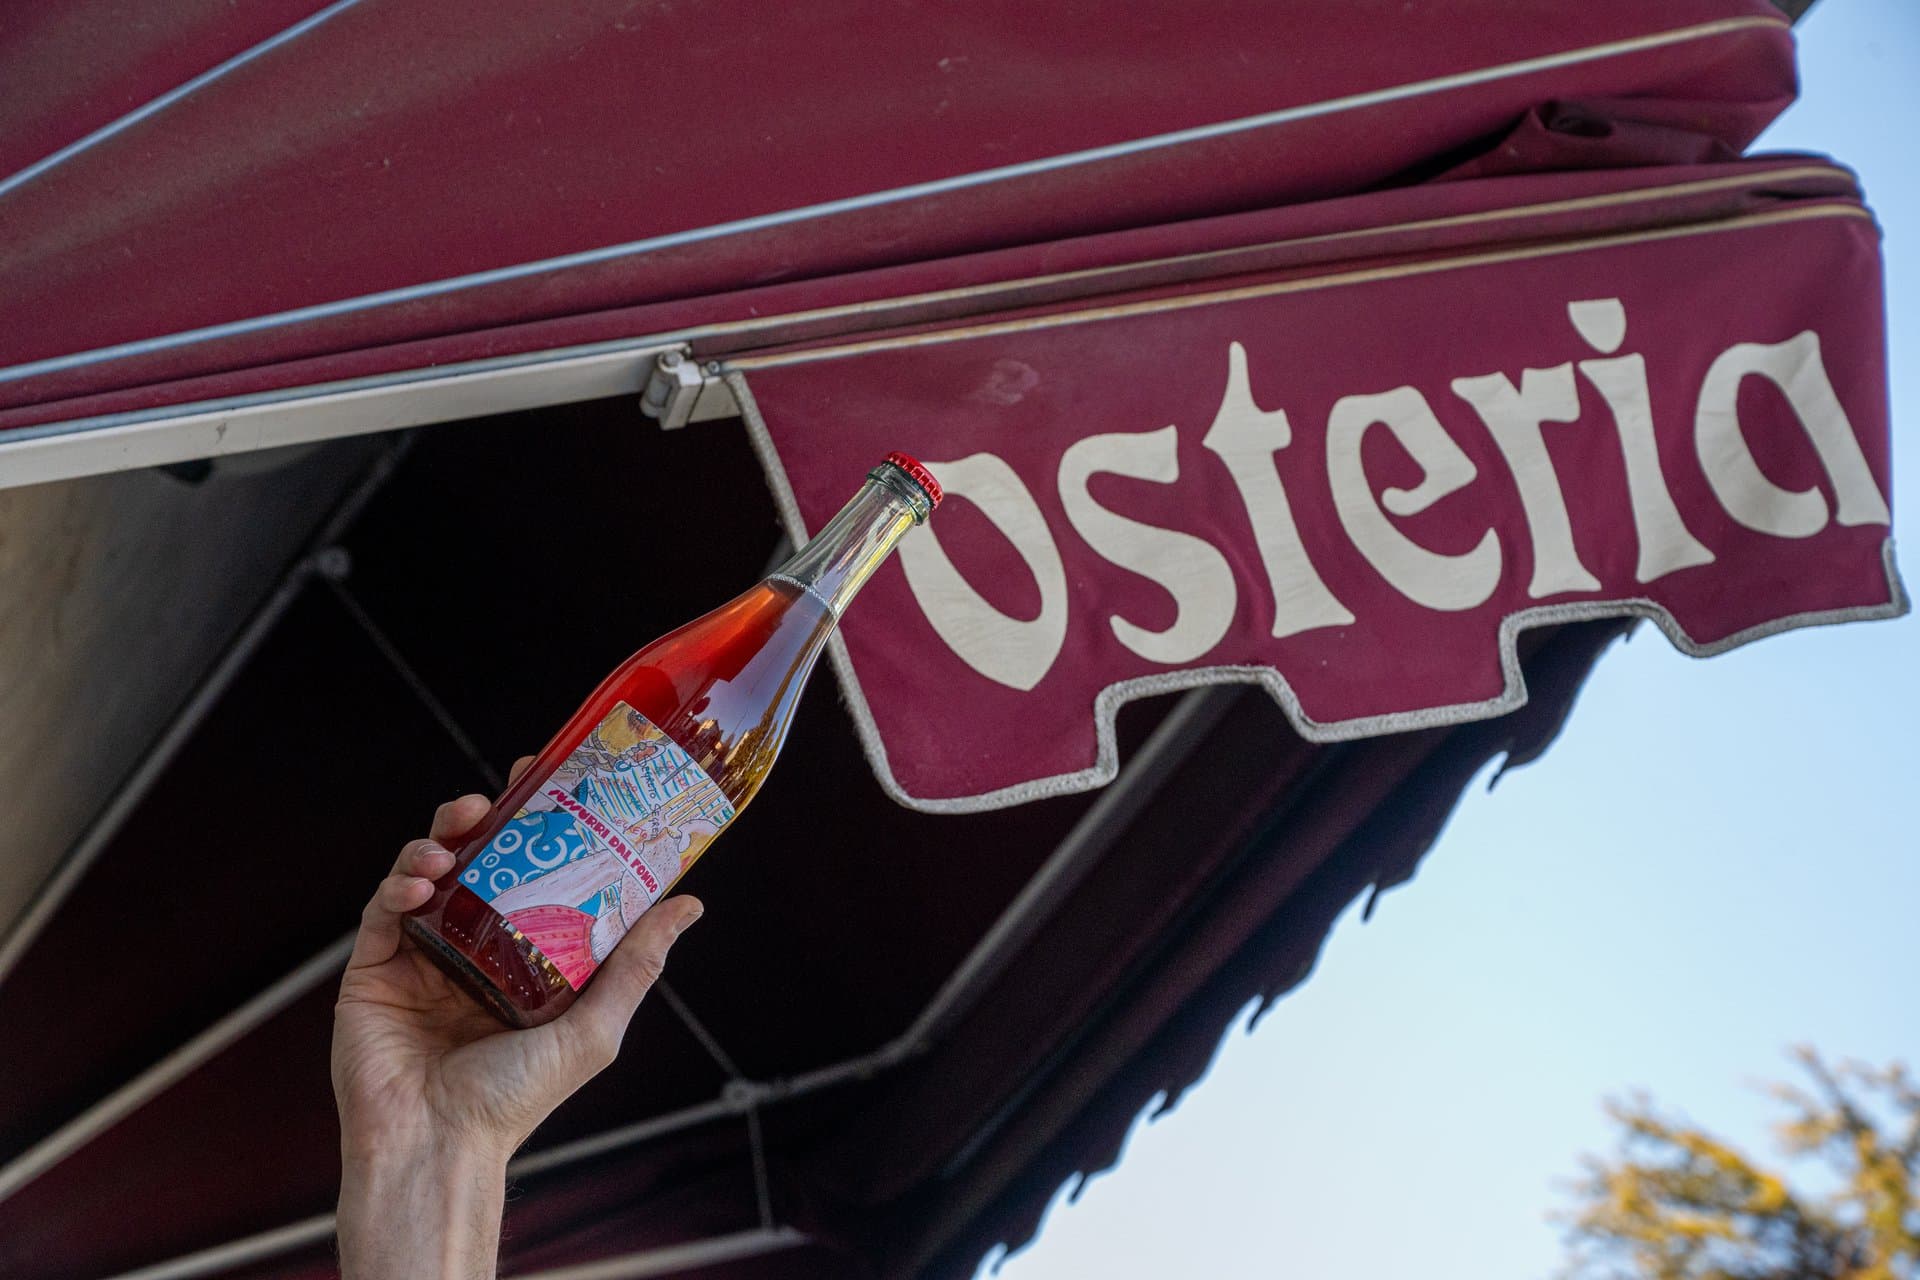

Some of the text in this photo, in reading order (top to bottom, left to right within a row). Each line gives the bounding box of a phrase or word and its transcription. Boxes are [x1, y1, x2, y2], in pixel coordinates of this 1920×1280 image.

[897, 297, 1889, 691] osteria
[547, 789, 611, 839] SUSSURRI
[608, 835, 632, 863] DAL
[630, 858, 658, 893] FONDO
